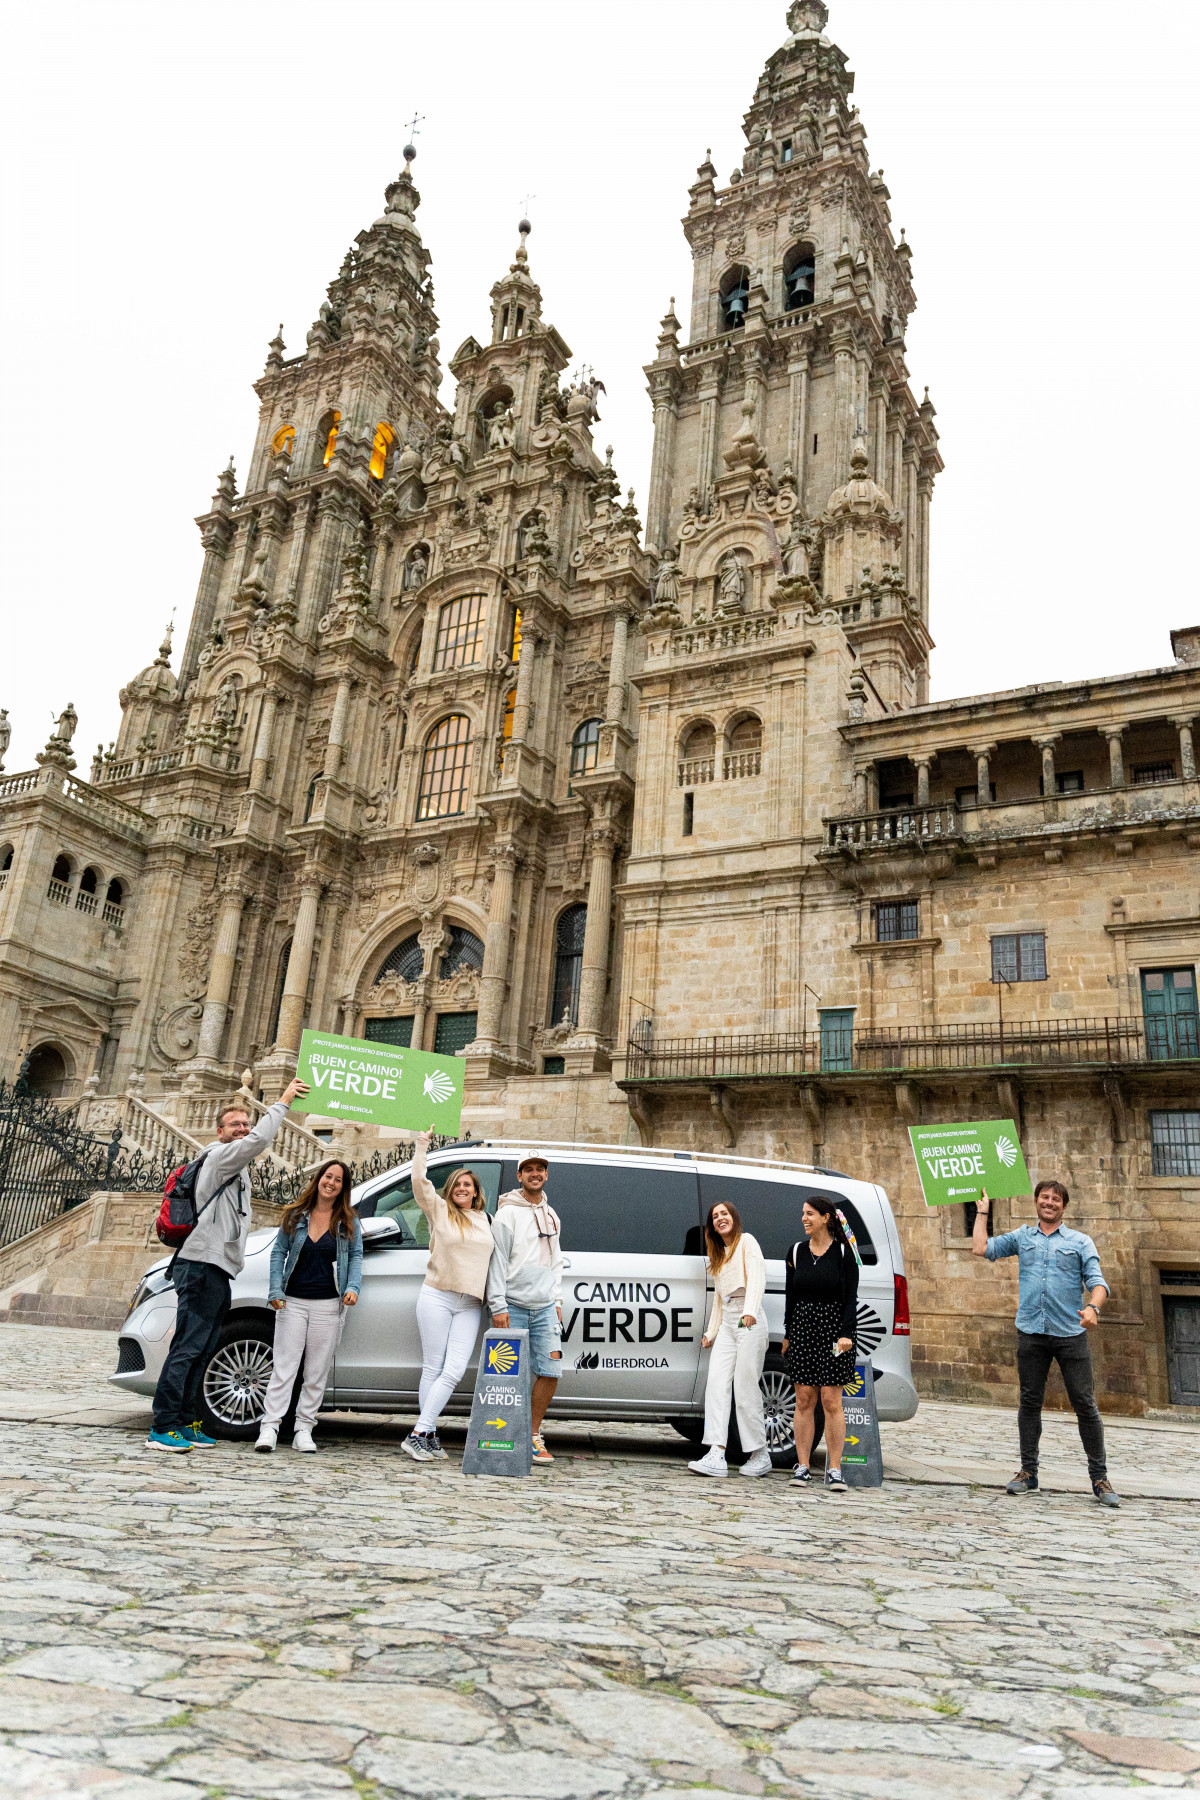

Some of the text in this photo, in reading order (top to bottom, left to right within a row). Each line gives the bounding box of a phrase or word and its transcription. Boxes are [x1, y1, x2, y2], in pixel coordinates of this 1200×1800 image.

[312, 1039, 404, 1060] ¡PROTEJAMOS NUESTRO ENTORNO!
[308, 1053, 403, 1079] ¡BUEN CAMINO!
[311, 1066, 398, 1100] VERDE
[340, 1104, 373, 1114] IBERDROLA
[921, 1143, 983, 1159] ¡BUEN CAMINO!
[926, 1155, 986, 1179] VERDE
[573, 1282, 671, 1304] CAMINO
[602, 1357, 669, 1368] IBERDROLA
[485, 1385, 516, 1394] CAMINO
[478, 1392, 523, 1406] VERDE
[842, 1406, 865, 1414] AMINO
[844, 1413, 871, 1425] ERDE
